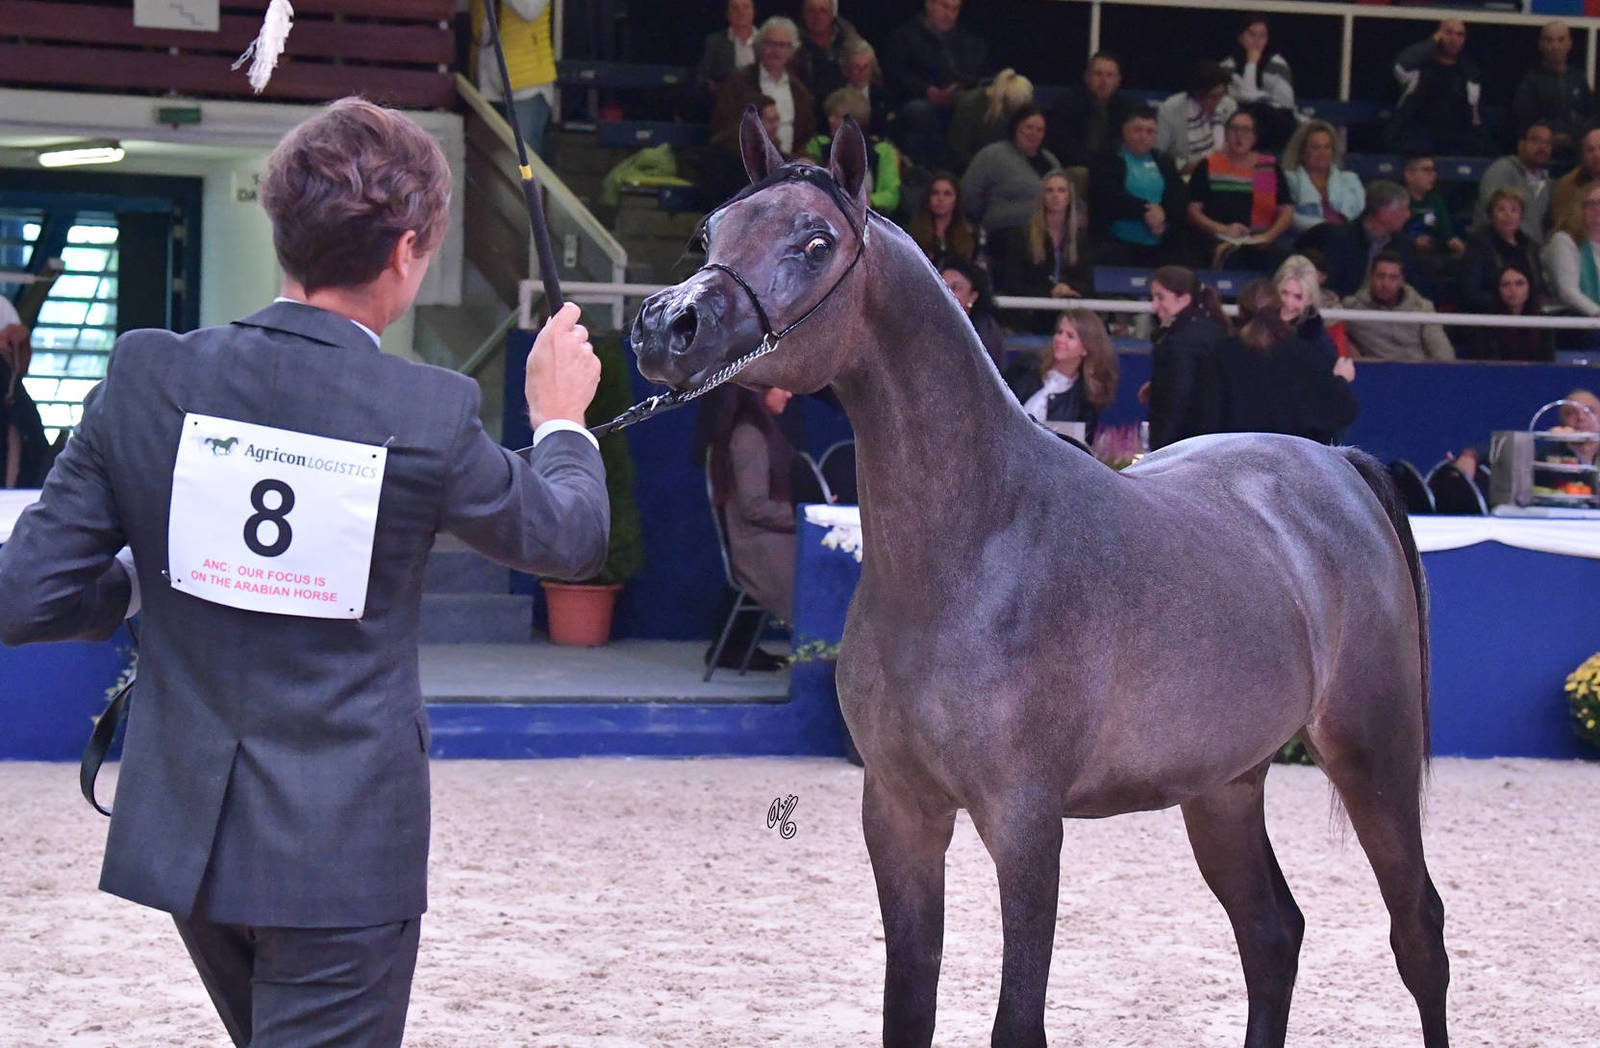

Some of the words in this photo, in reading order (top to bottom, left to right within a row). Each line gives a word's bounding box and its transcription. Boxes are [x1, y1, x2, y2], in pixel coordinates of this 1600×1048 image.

[243, 479, 295, 557] 8
[191, 570, 207, 582] ON
[210, 575, 231, 588] THE
[234, 580, 290, 596] ARABIAN
[294, 589, 338, 602] HORSE
[203, 558, 231, 572] ANC:
[238, 566, 264, 579] OUR
[267, 570, 311, 585] FOCUS
[314, 576, 327, 587] IS
